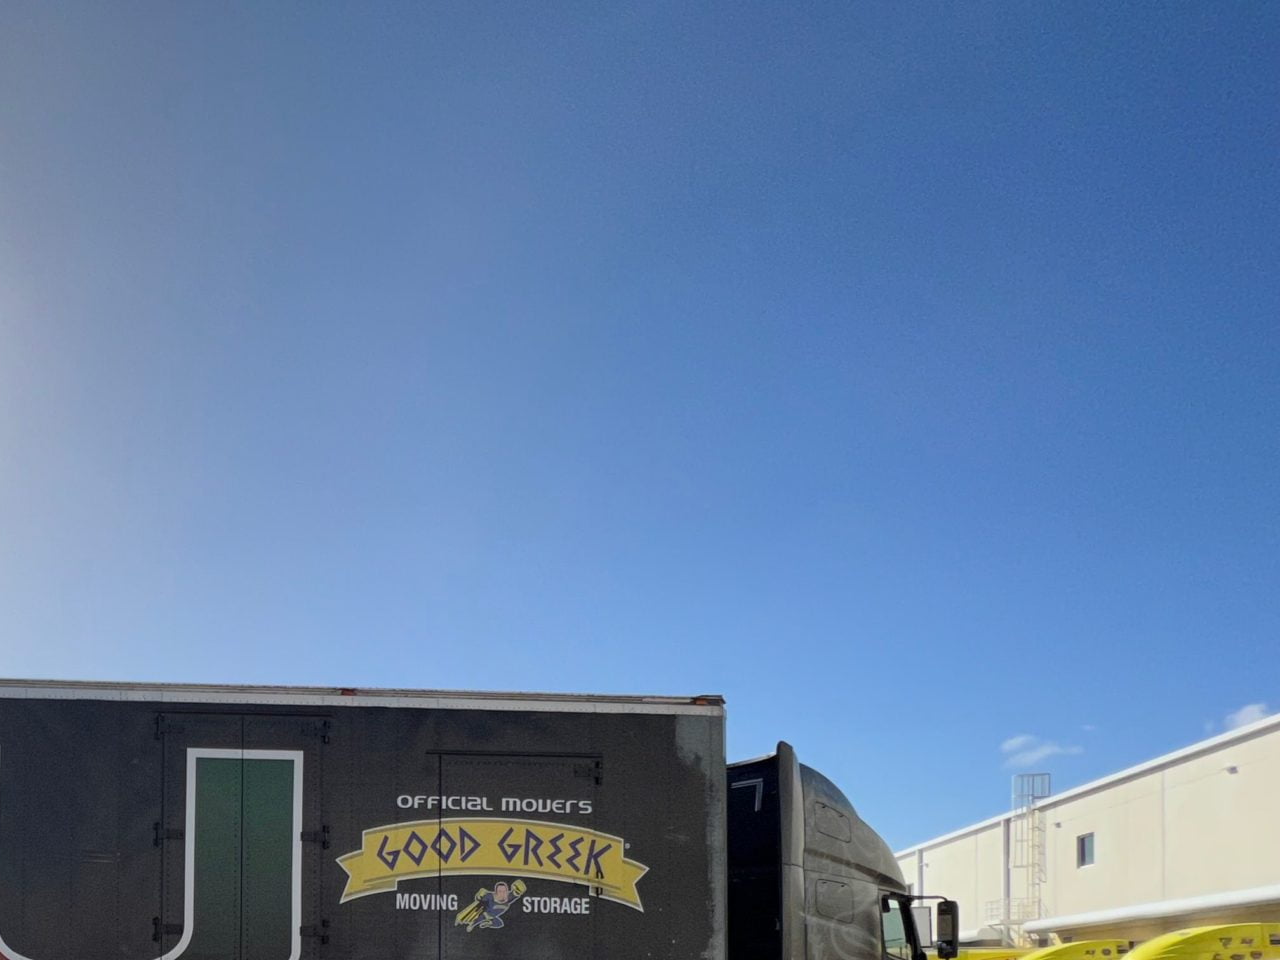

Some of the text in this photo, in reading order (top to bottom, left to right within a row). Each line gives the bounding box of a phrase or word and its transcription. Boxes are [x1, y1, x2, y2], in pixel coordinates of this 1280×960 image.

[396, 795, 493, 811] OFFICIAL
[377, 826, 612, 875] GOOD GREEK
[395, 893, 590, 914] MOVING STORAGE
